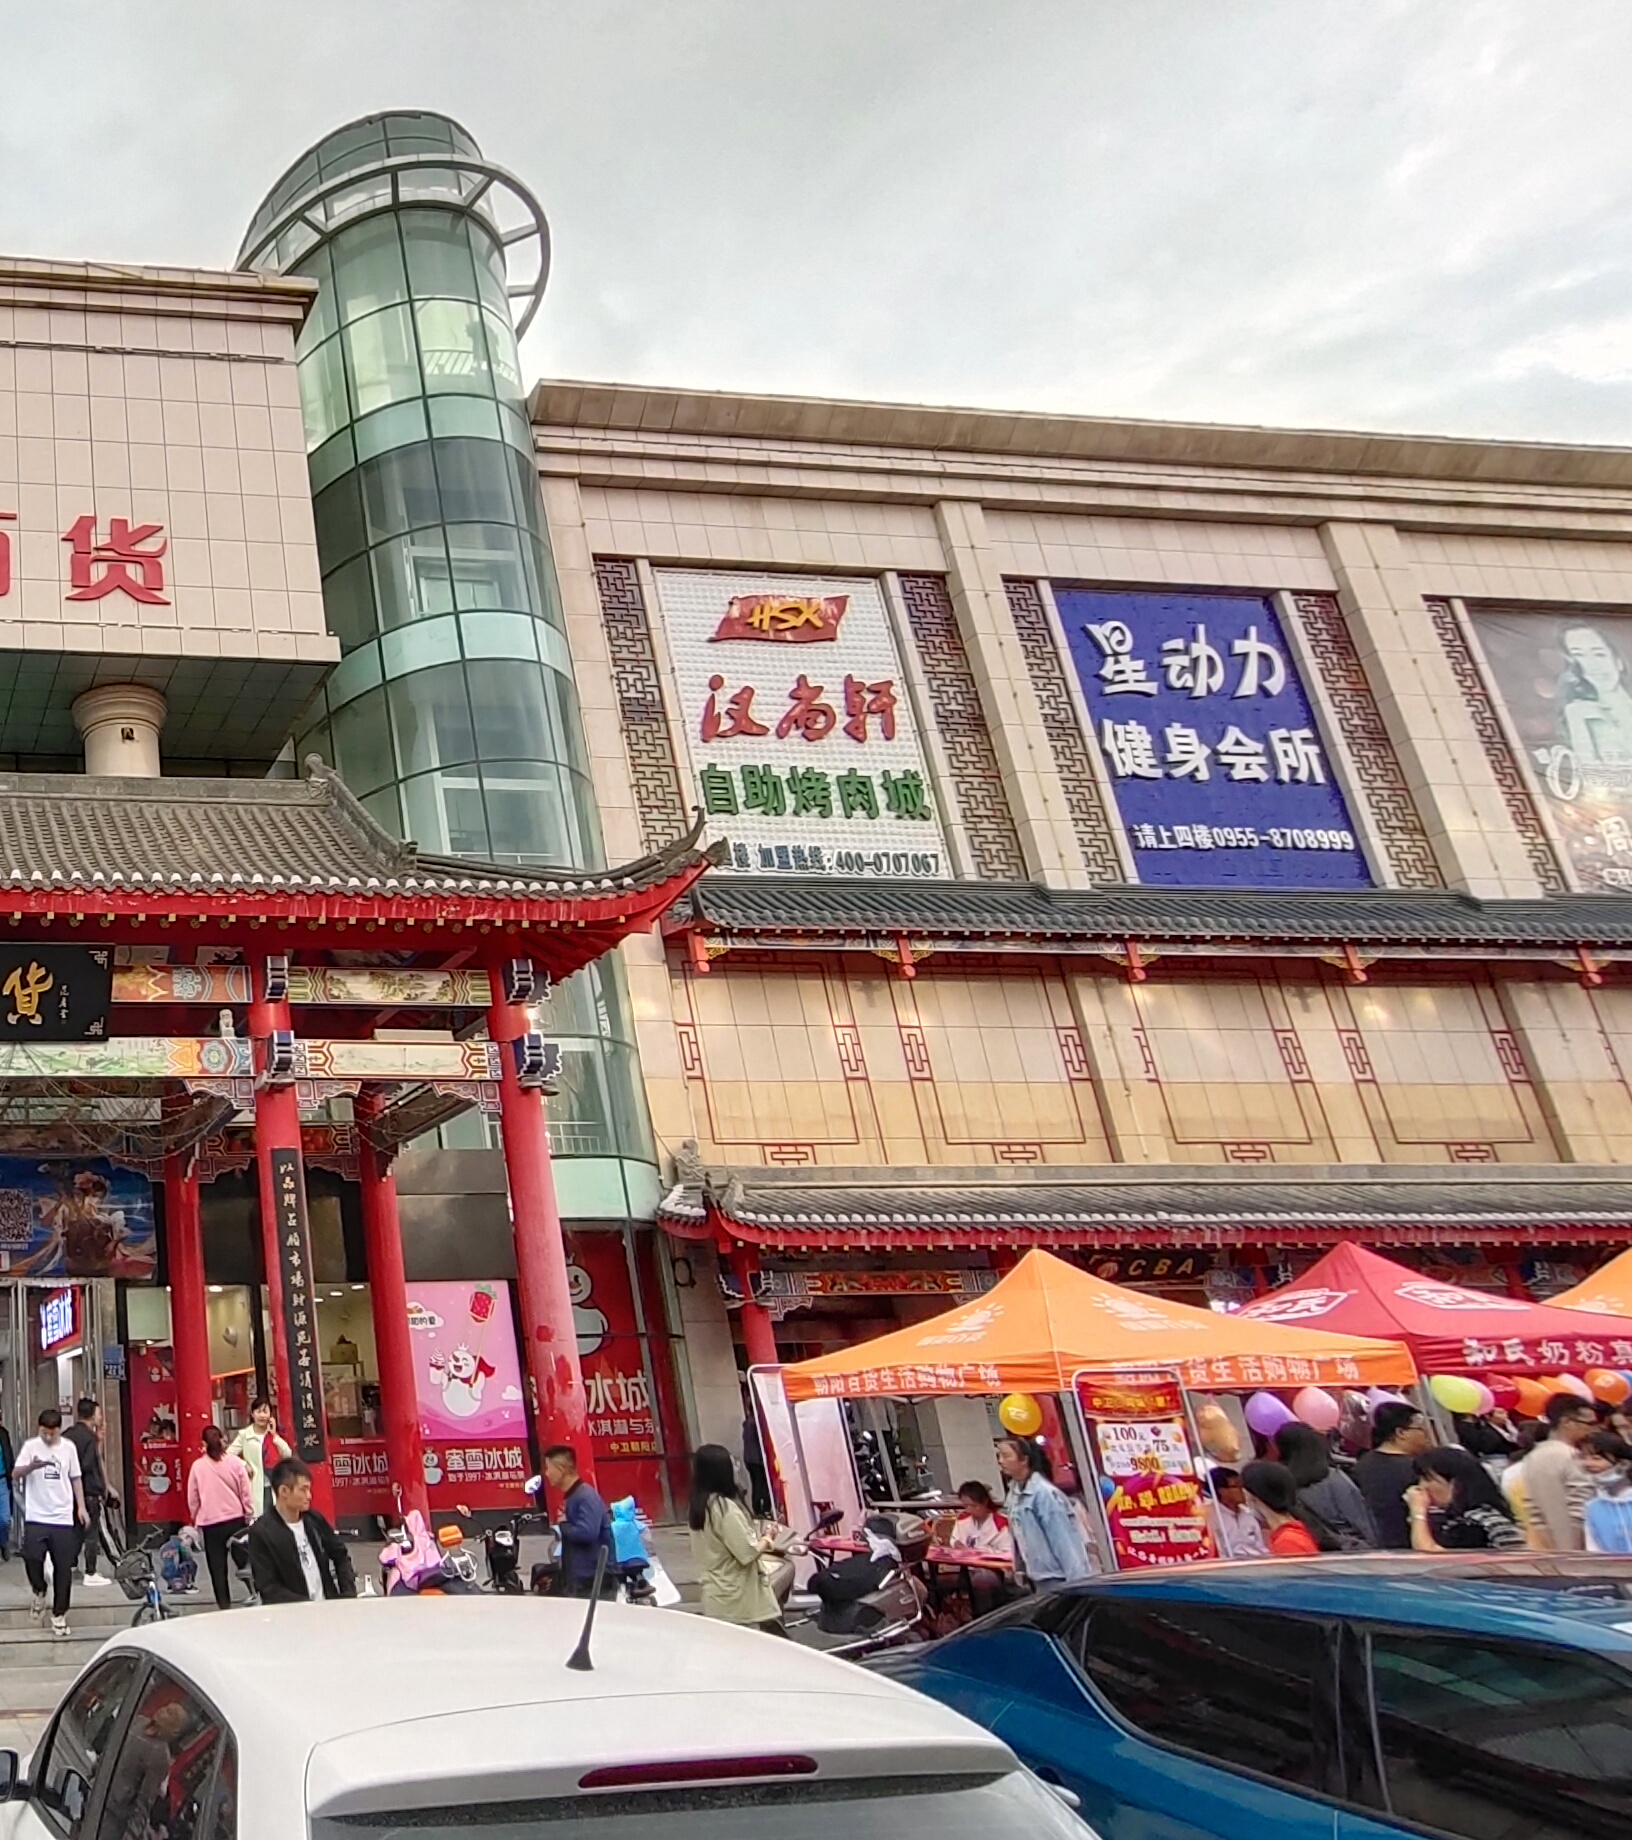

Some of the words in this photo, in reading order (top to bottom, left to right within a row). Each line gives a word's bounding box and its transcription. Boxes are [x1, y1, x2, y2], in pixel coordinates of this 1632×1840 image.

[747, 602, 823, 632] HSX
[1085, 621, 1286, 698] 星动力
[1102, 718, 1326, 784] 健身会所
[700, 763, 932, 820] 自助烤肉城
[1132, 824, 1355, 850] 请上四楼0955-8708999
[1127, 1257, 1195, 1277] CBA
[445, 1447, 525, 1471] 蜜雪冰城
